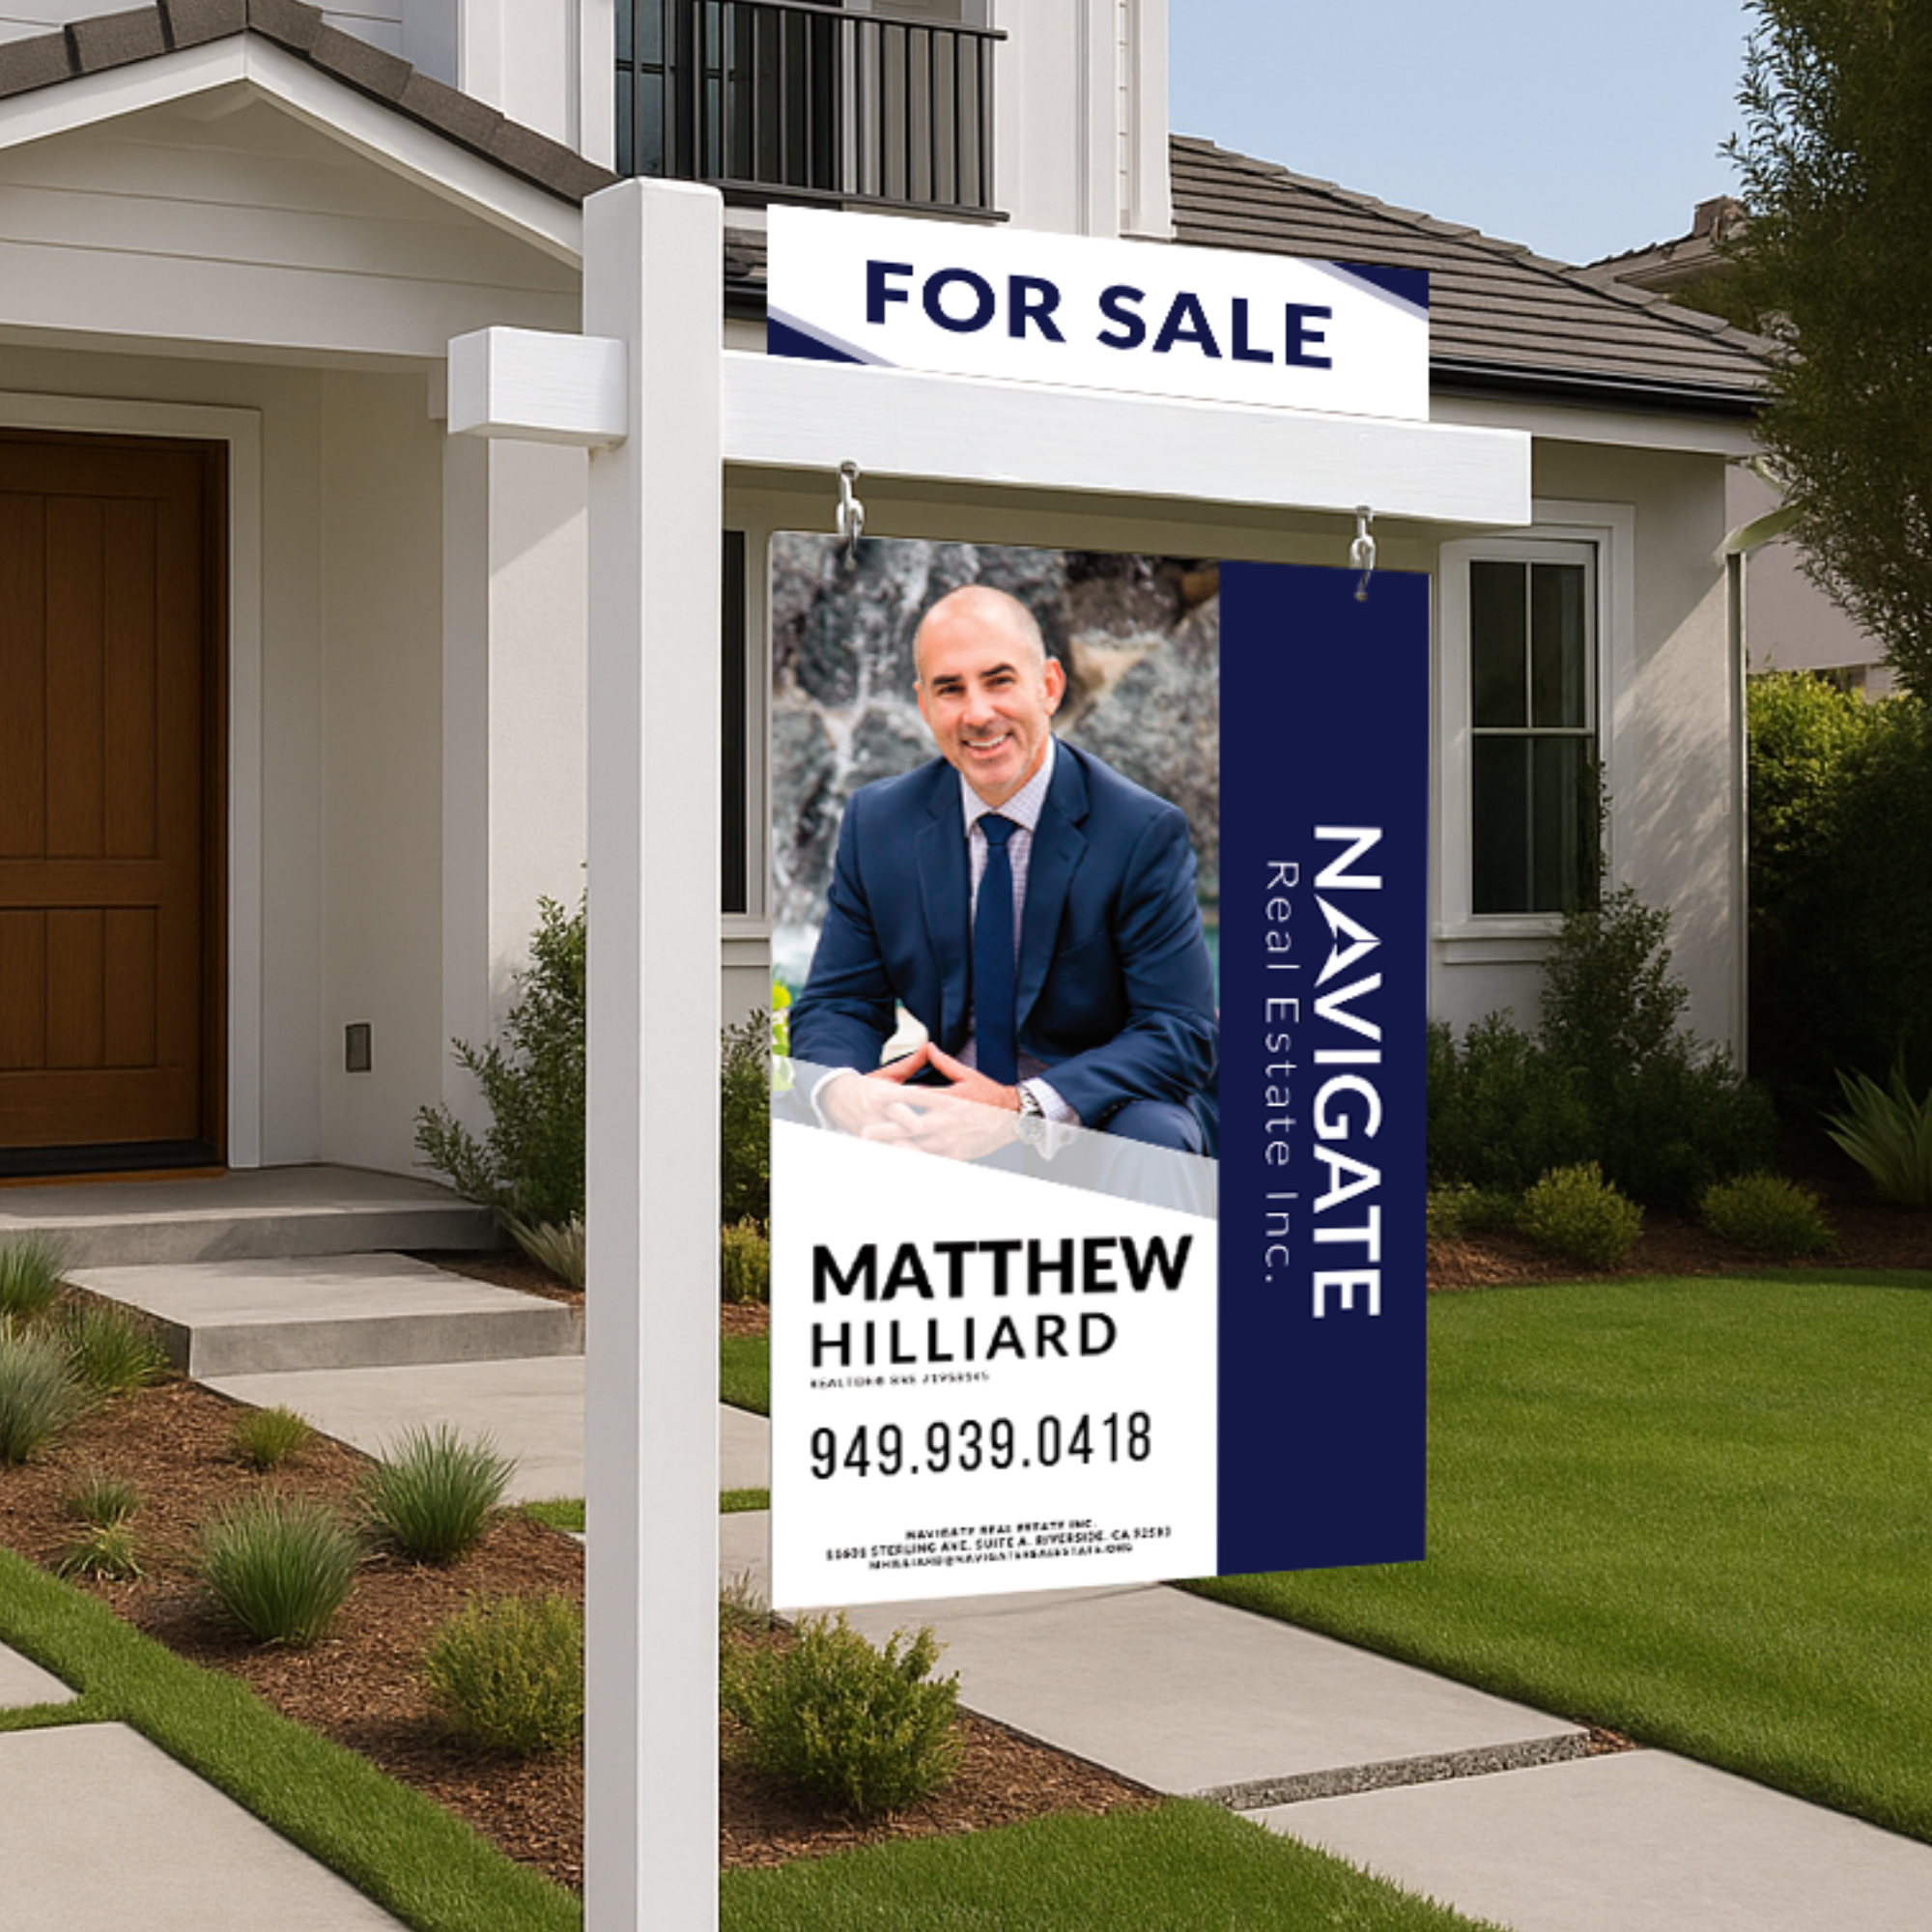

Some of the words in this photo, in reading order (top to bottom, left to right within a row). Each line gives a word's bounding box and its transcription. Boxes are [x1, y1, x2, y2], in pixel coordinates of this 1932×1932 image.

[867, 260, 1065, 342] FOR
[1096, 285, 1332, 369] SALE
[1265, 862, 1300, 969] Real
[1265, 998, 1299, 1165] Estate
[1314, 827, 1381, 1318] NAVIGATE
[813, 1235, 1193, 1303] MATTHEW
[1265, 1193, 1297, 1281] Inc.
[812, 1313, 1117, 1368] HILLIARD
[811, 1411, 1151, 1479] 949.939.0418
